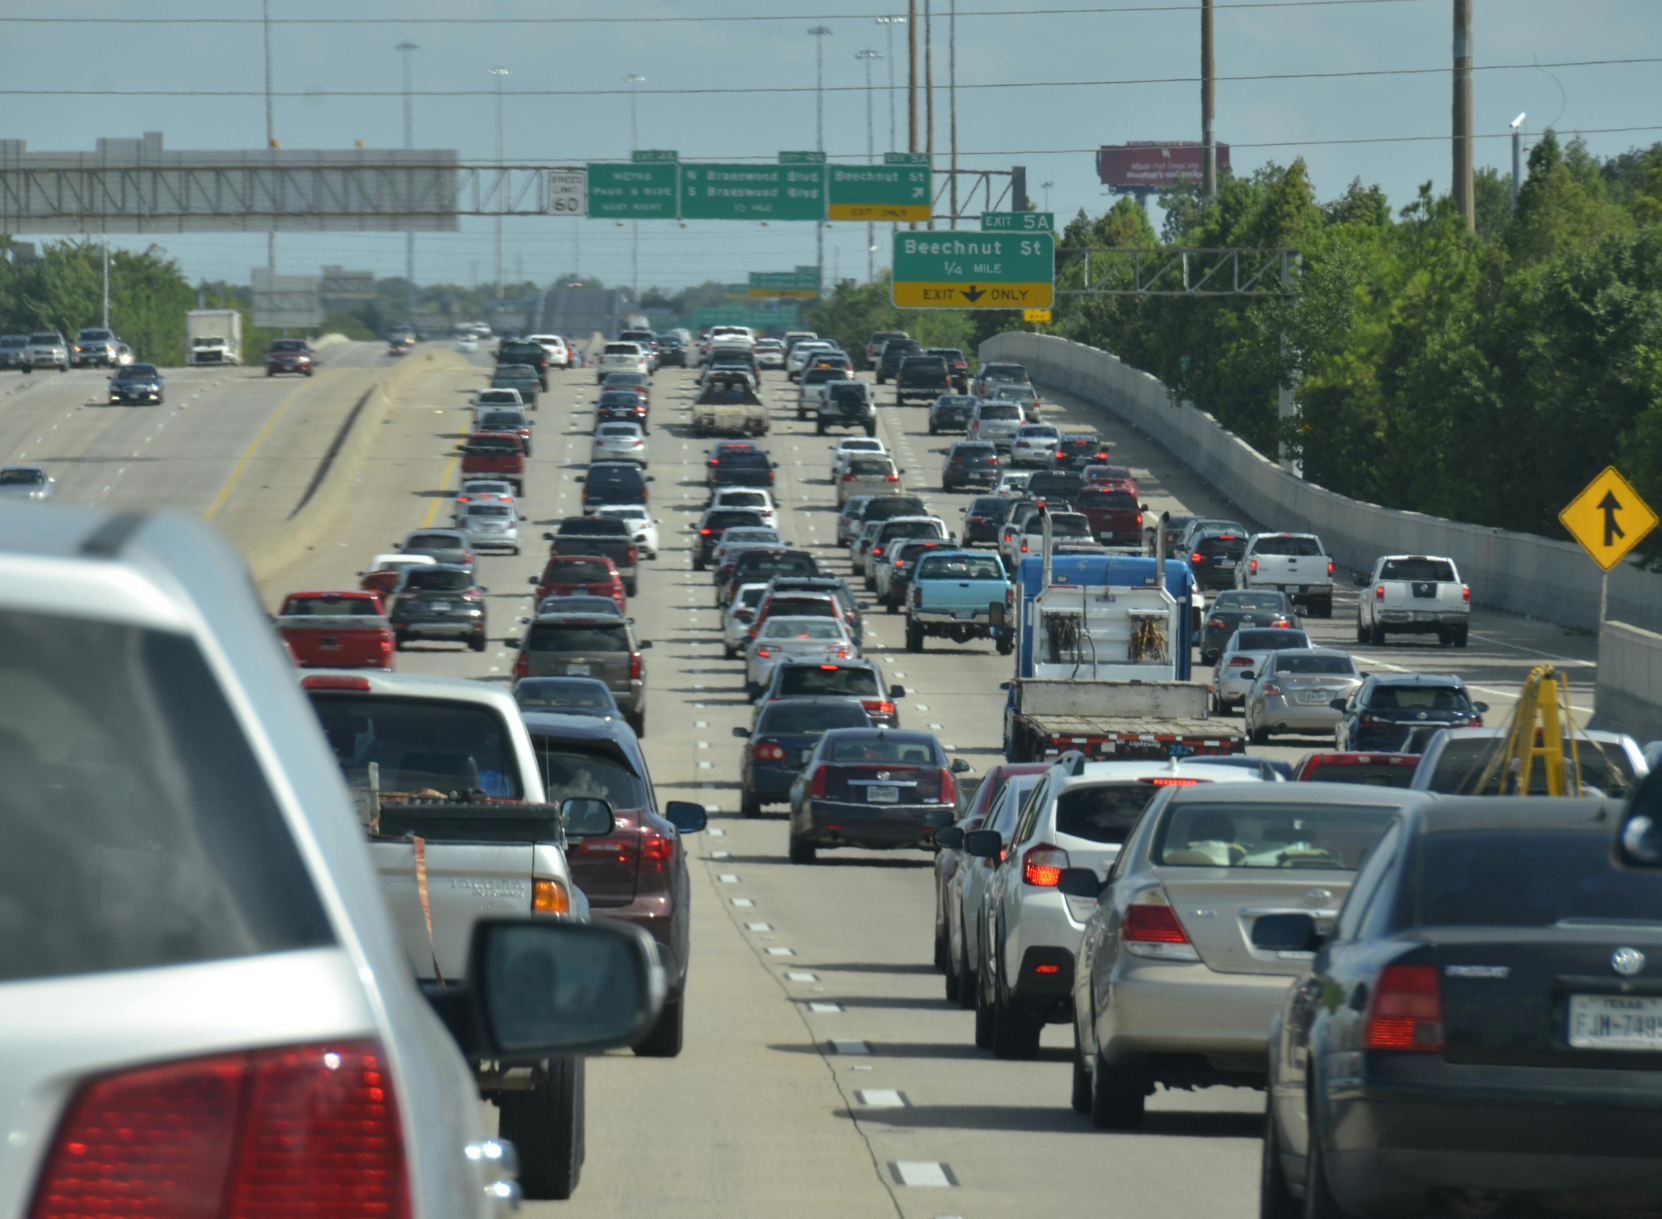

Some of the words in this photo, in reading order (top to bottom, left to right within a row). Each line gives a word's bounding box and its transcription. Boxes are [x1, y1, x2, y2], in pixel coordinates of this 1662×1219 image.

[550, 176, 583, 184] SPEED
[835, 171, 899, 182] Beechnut
[909, 172, 925, 182] St
[593, 187, 623, 196] PARK
[644, 187, 672, 196] RIDE
[554, 197, 579, 212] 60
[985, 216, 1012, 227] EXIT
[1023, 215, 1050, 229] 5A
[905, 239, 1002, 255] Beechnut
[1020, 240, 1041, 256] St
[974, 264, 1002, 274] MILE
[923, 288, 955, 300] EXIT
[990, 289, 1029, 301] ONLY
[1129, 740, 1161, 749] Lightning
[1169, 745, 1189, 755] 282
[1603, 999, 1643, 1009] TEXAS
